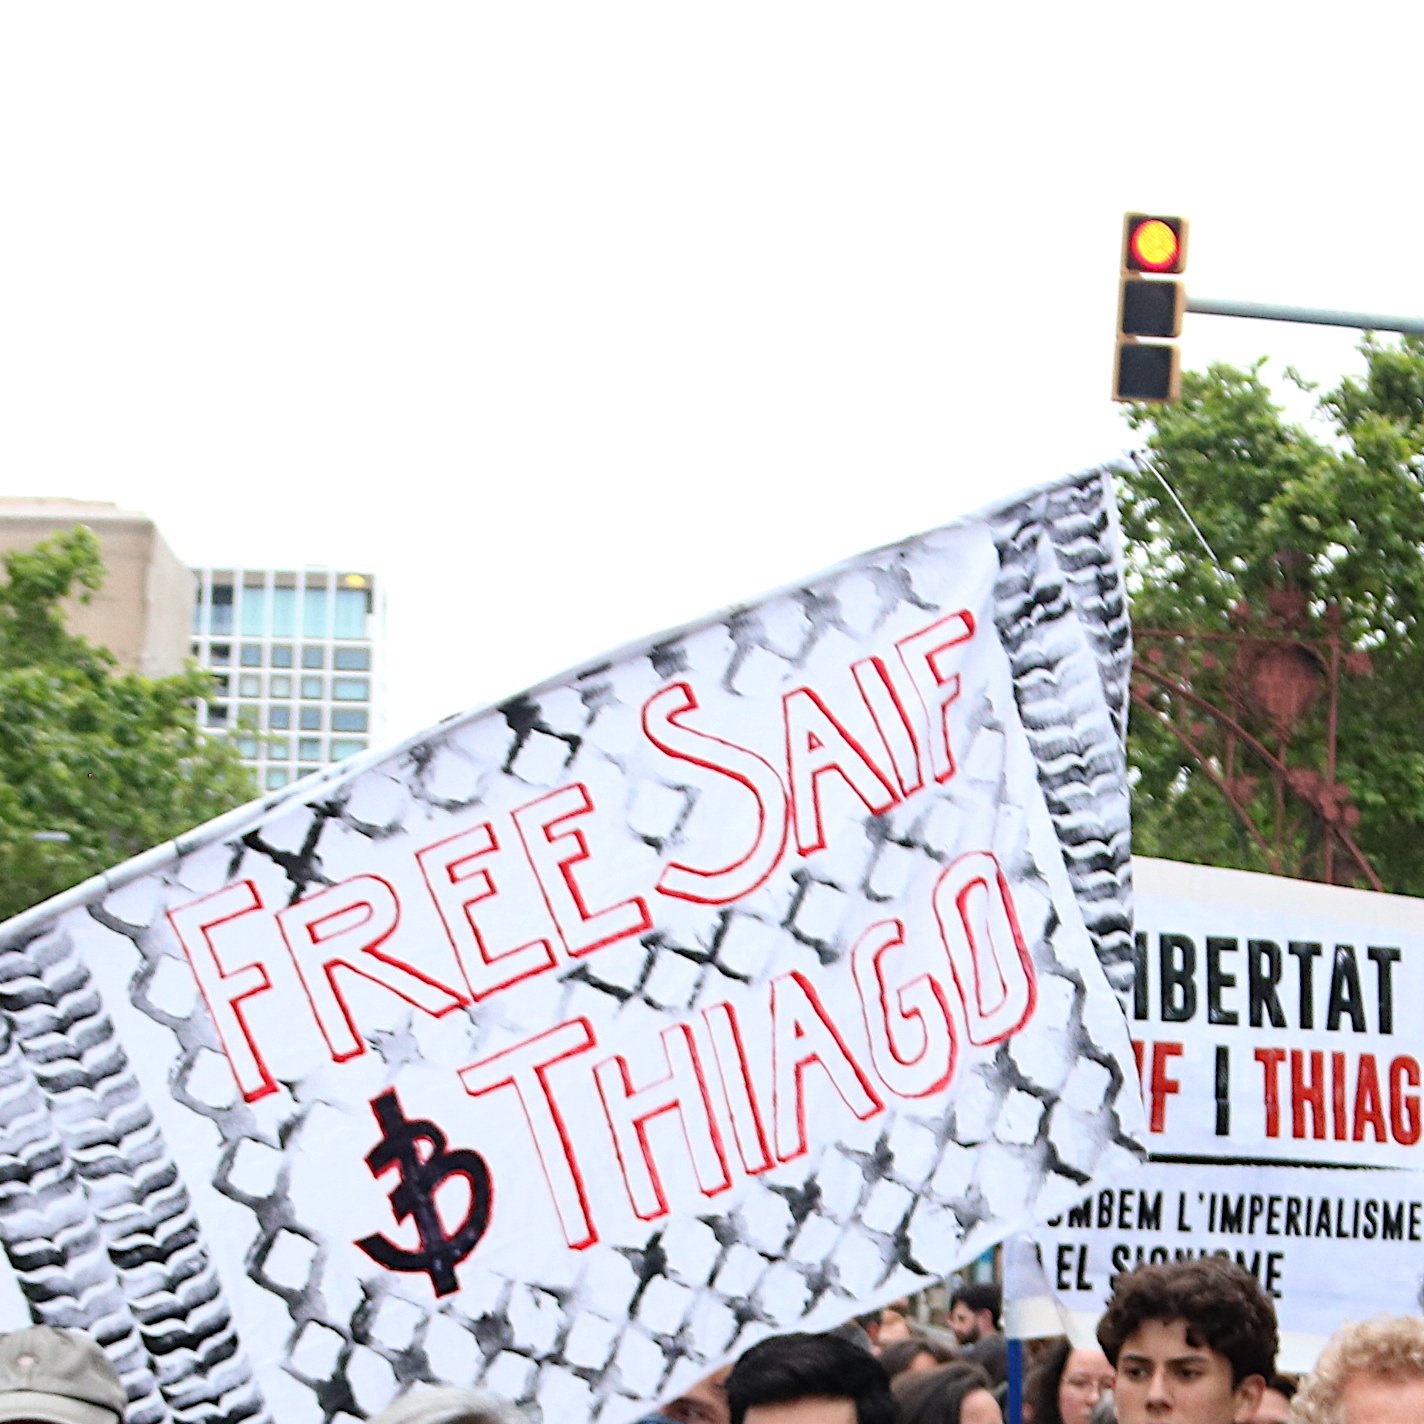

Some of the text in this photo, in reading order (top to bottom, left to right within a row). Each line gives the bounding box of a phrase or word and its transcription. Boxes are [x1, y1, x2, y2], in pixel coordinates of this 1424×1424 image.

[167, 609, 975, 1101] FREE SAIF
[1134, 932, 1401, 1035] IBERTAT
[459, 850, 1036, 1250] THIAGO
[1215, 1045, 1230, 1136] I
[1047, 1188, 1423, 1242] MBEM L'IMPERIALISME
[1057, 1243, 1092, 1291] EL
